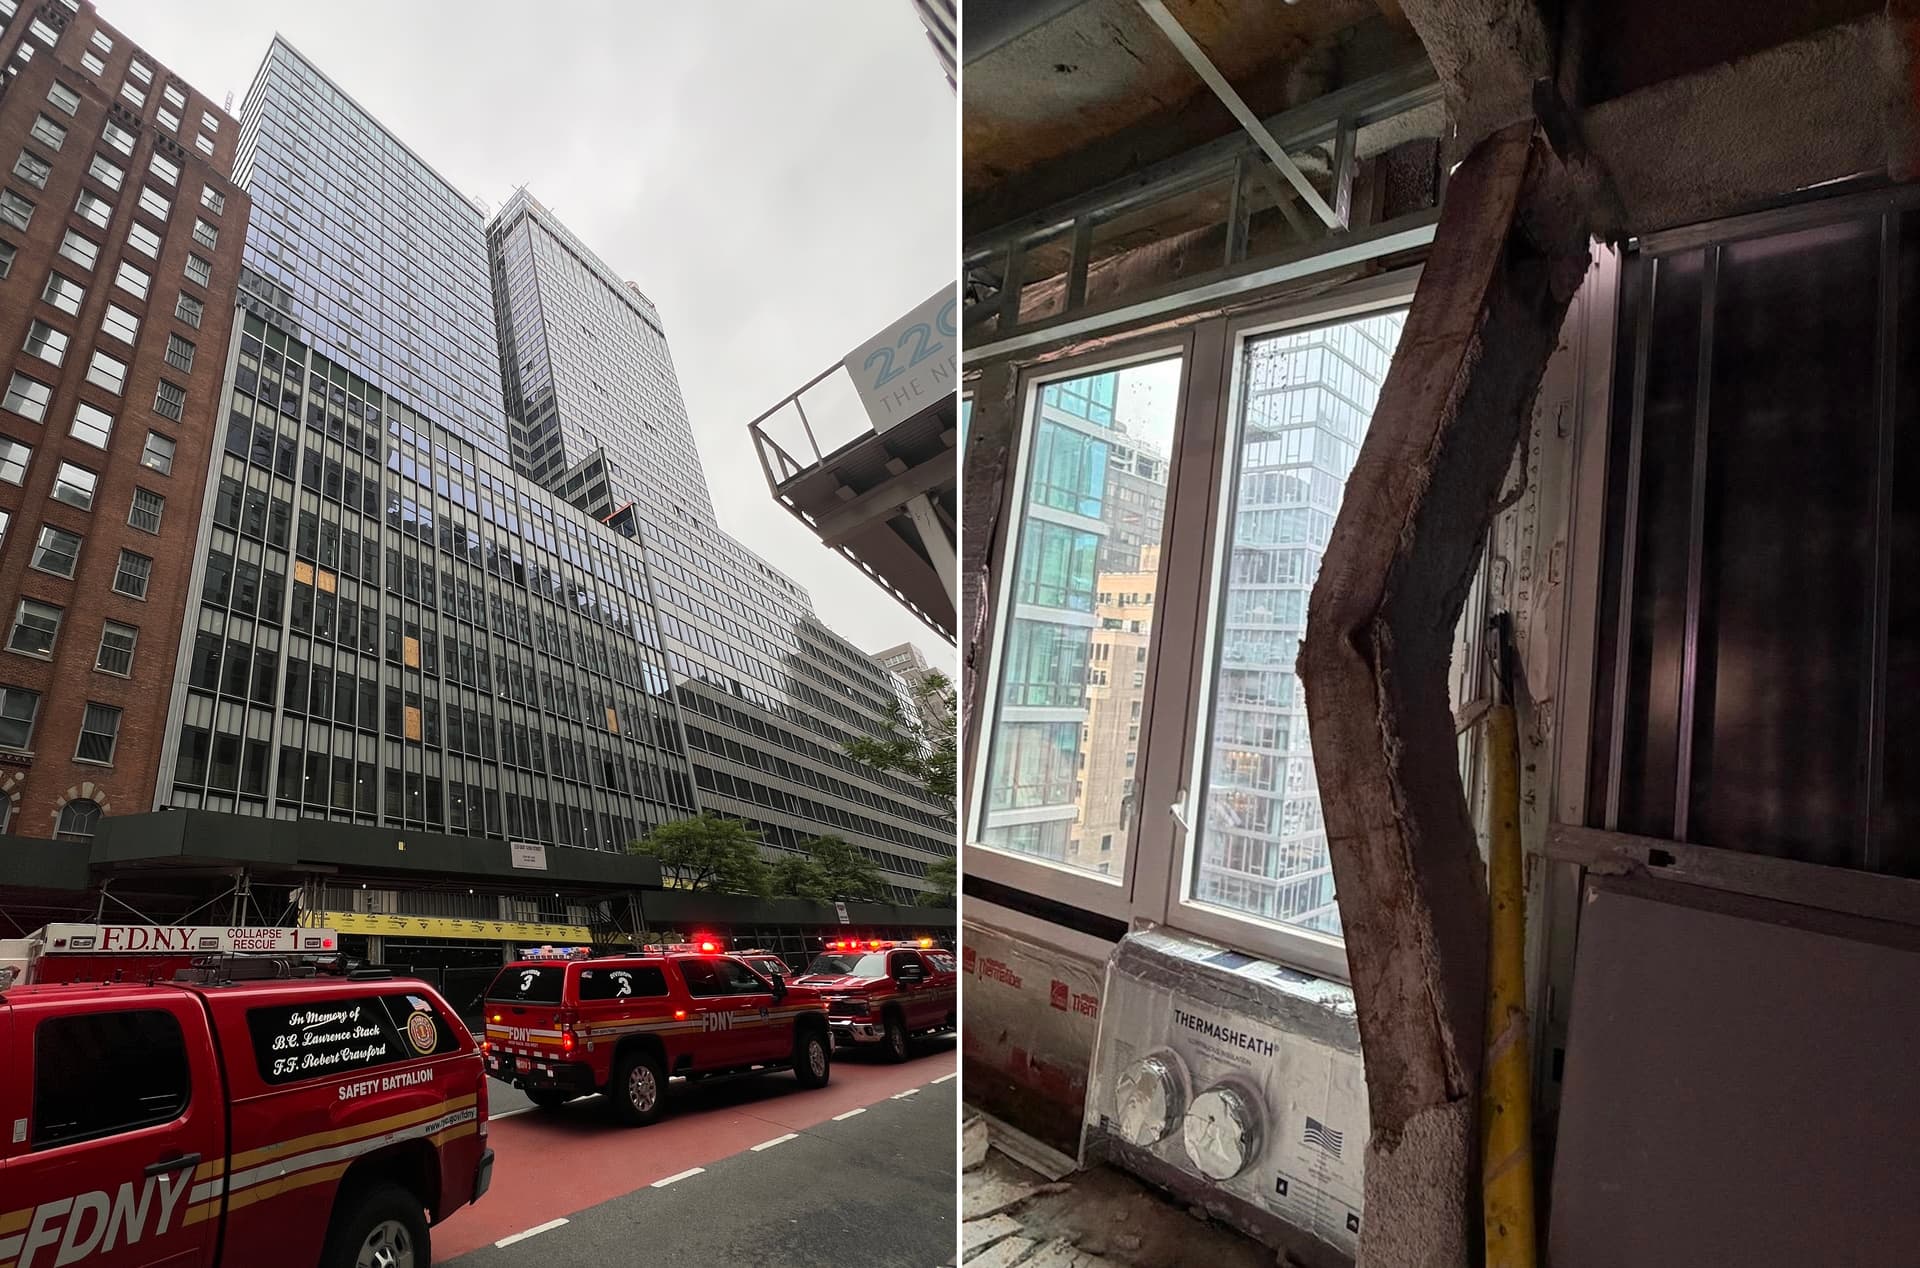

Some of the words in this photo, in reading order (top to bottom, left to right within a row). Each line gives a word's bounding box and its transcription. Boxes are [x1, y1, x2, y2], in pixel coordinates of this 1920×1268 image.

[880, 378, 925, 412] THE
[98, 927, 198, 950] F.D.N.Y.
[227, 928, 282, 939] COLLAPSE
[233, 939, 276, 949] RESCUE
[290, 929, 299, 950] 1
[520, 975, 533, 991] 3
[617, 977, 632, 995] 3
[289, 1013, 304, 1026] In
[304, 1010, 348, 1028] Memory
[349, 1006, 360, 1021] of
[702, 1011, 735, 1032] FDNY
[272, 1034, 300, 1050] B.C.
[302, 1031, 351, 1047] Laurence
[353, 1025, 380, 1039] Stack
[509, 1027, 531, 1041] FDNY
[273, 1057, 299, 1076] F.F.
[302, 1051, 340, 1070] Robert
[340, 1044, 386, 1062] Crawford
[338, 1079, 380, 1100] SAFETY
[382, 1068, 433, 1091] BATTALION
[18, 1166, 196, 1268] FDNY
